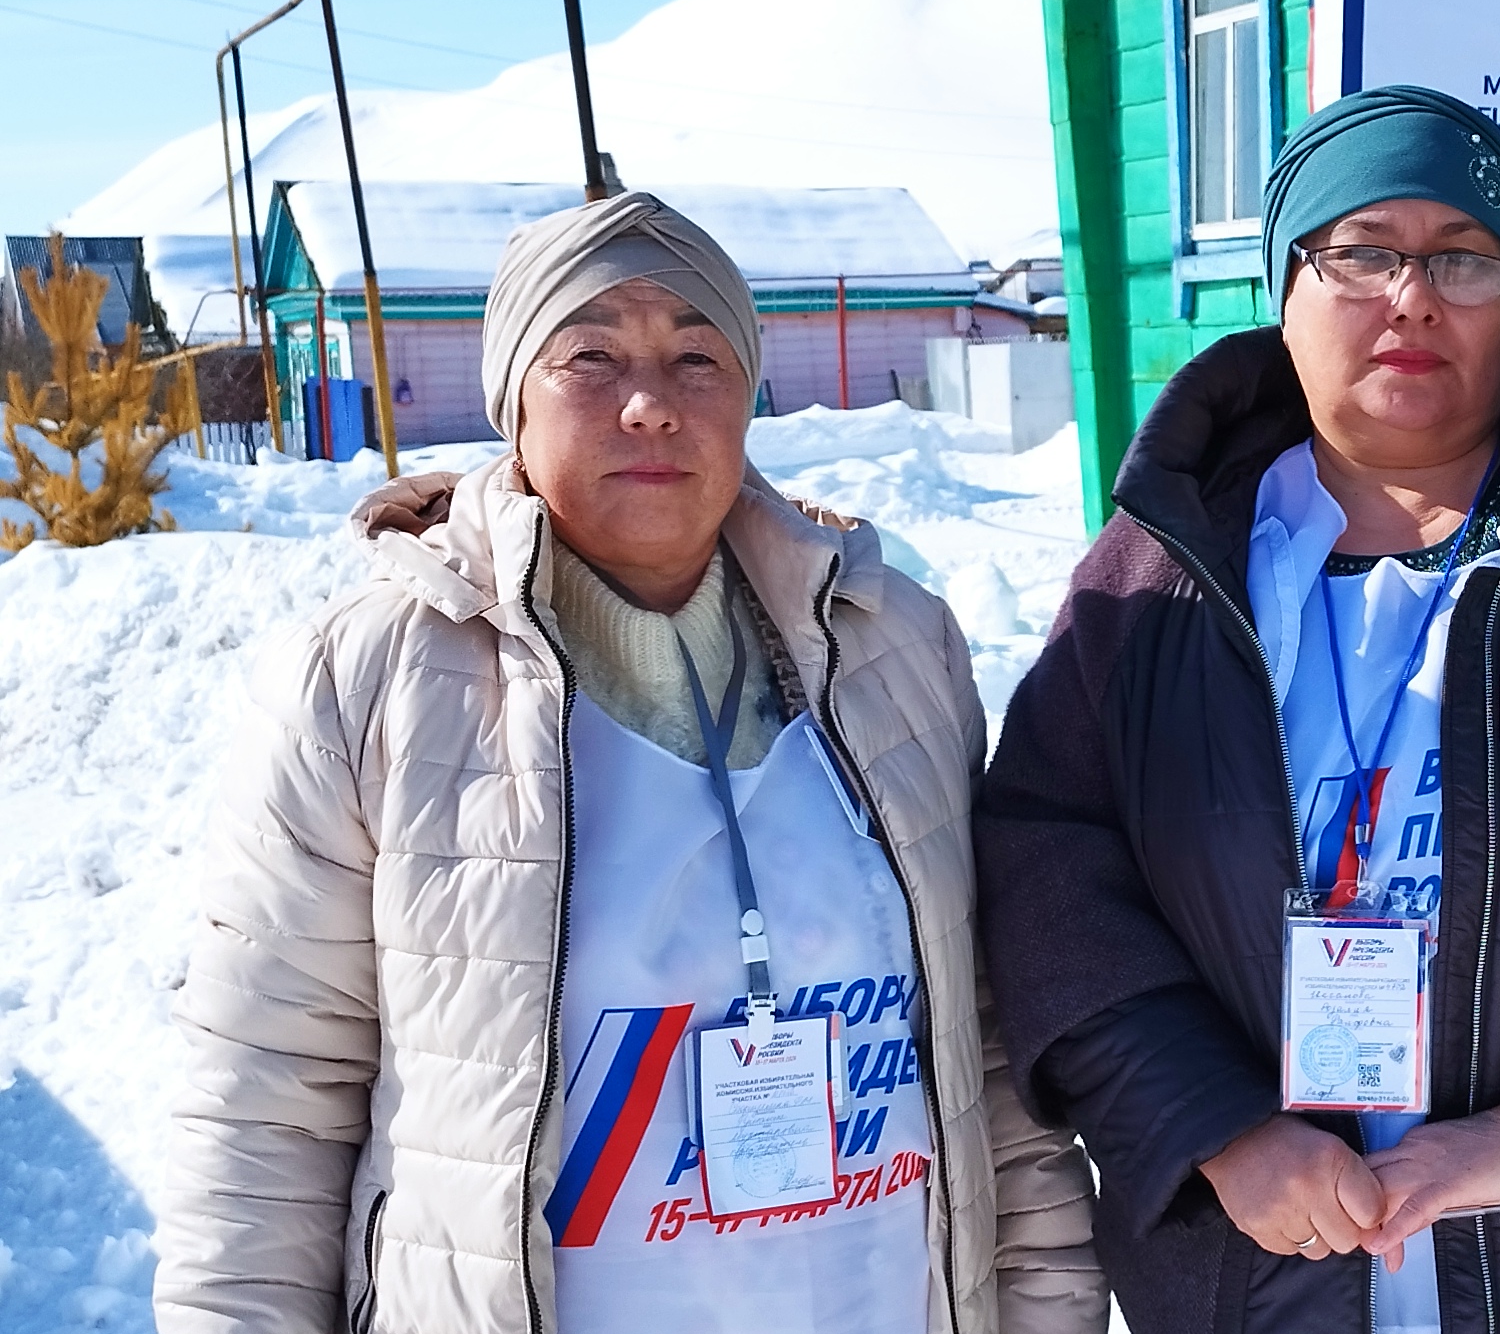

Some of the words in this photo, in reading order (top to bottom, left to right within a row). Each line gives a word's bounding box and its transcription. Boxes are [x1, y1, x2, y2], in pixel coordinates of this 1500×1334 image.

[771, 1031, 794, 1041] БОРЫ
[715, 1079, 759, 1089] УЧАСТКОВАЯ
[759, 1072, 815, 1084] ИЗБИРАТЕЛЬНАЯ
[716, 1087, 754, 1098] КОМИССИЯ
[754, 1080, 813, 1092] ИЗБИРАТЕЛЬНОГО
[731, 1095, 762, 1103] УЧАСТКА
